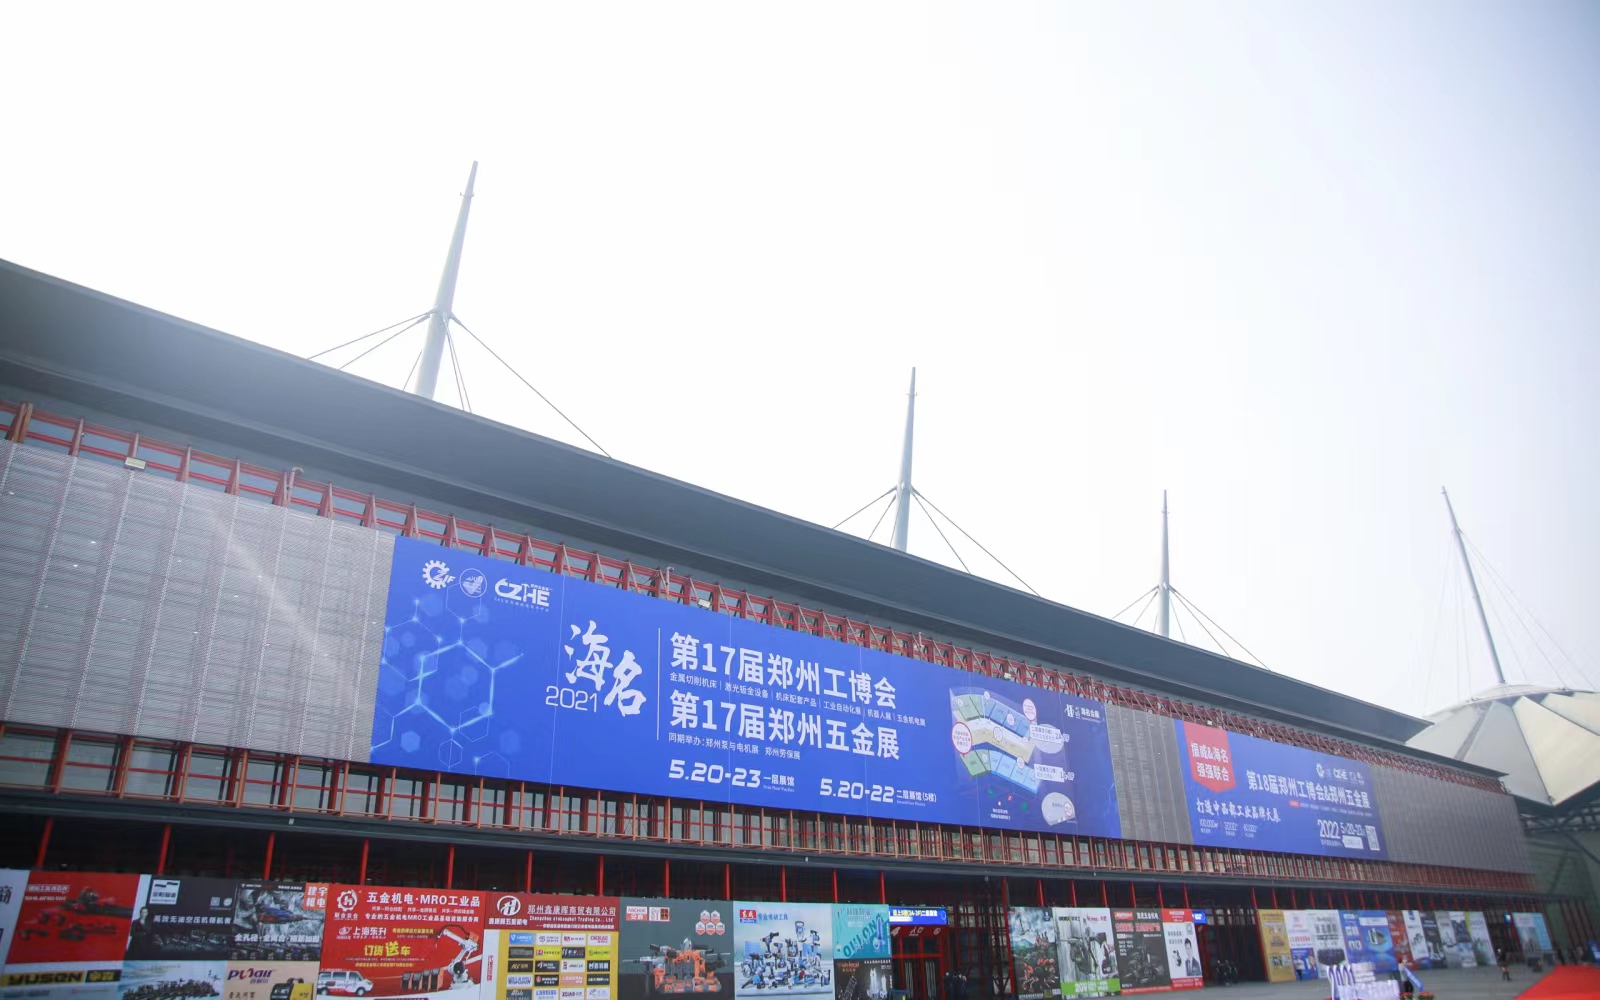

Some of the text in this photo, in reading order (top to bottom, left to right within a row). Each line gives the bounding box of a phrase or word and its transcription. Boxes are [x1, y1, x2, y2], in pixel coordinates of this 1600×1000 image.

[564, 619, 648, 718] 海名
[669, 631, 897, 710] 第17届郑州工博会
[545, 685, 598, 713] 2021
[669, 688, 900, 761] 第17届郑州五金展
[668, 759, 761, 789] 5.20-23
[819, 778, 895, 803] 5.20-22
[366, 891, 481, 908] 五金机电·MRO工业品
